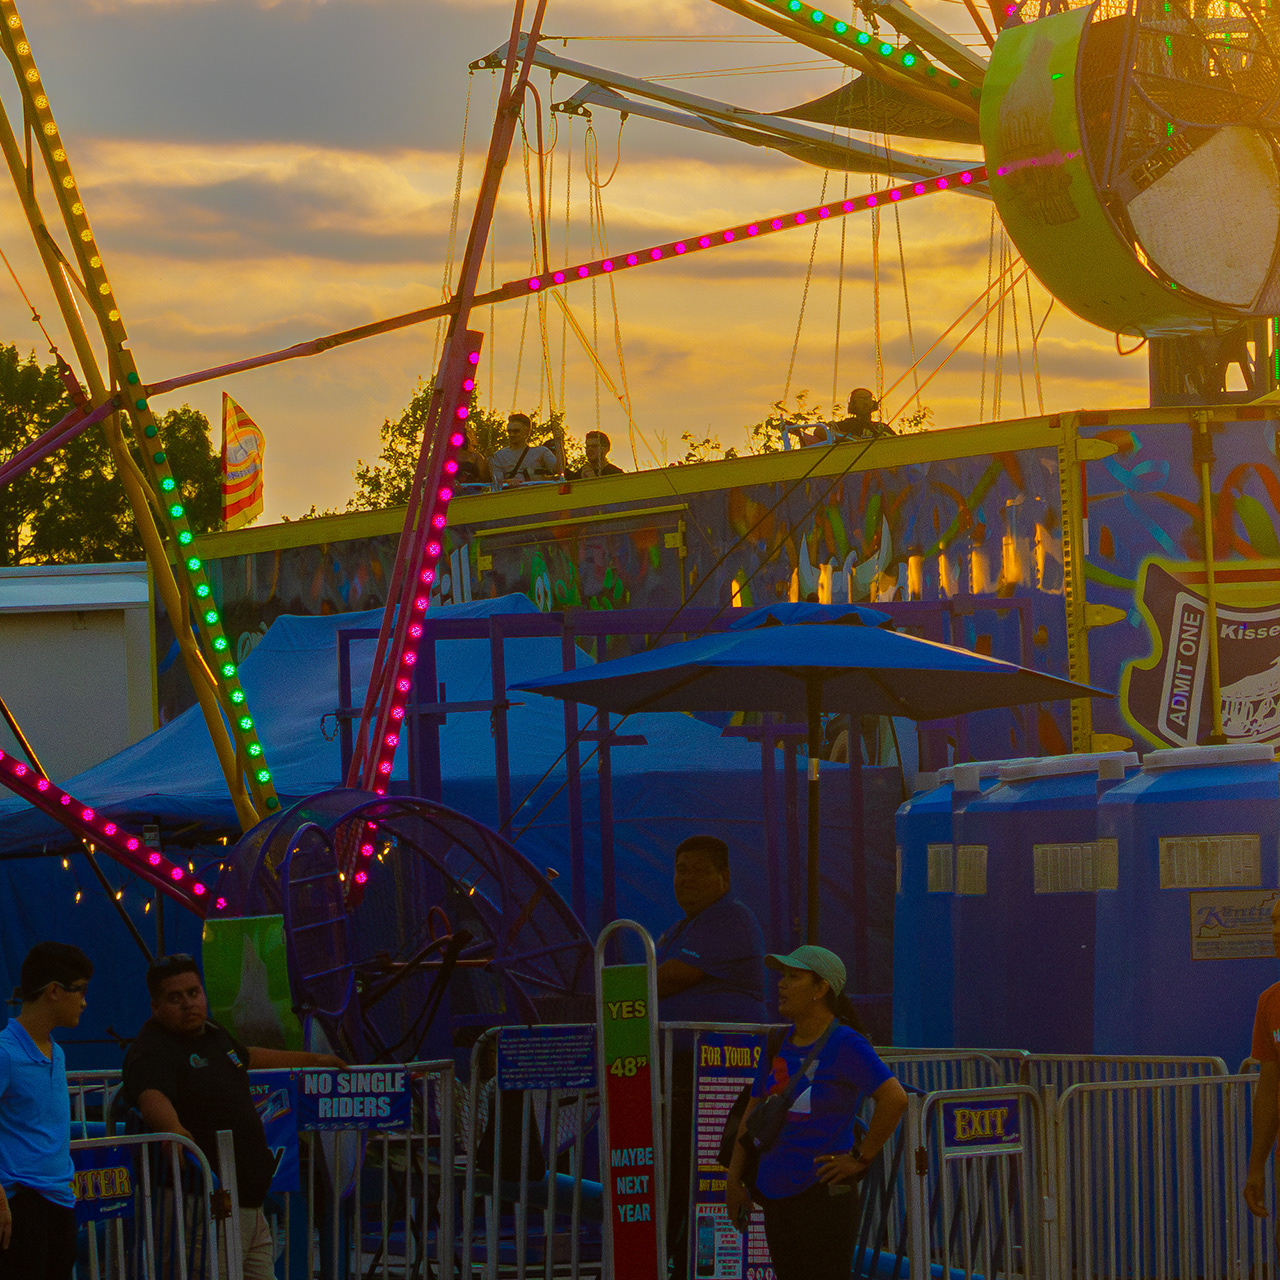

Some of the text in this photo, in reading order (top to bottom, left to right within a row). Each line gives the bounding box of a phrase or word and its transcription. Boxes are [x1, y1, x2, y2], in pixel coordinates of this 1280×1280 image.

[1169, 612, 1201, 727] ADMIT ONE
[607, 1000, 647, 1019] YES
[701, 1045, 721, 1067] FOR
[723, 1045, 751, 1068] YOUR
[304, 1072, 405, 1094] NO SINGLE
[318, 1096, 391, 1118] RIDERS
[953, 1106, 1009, 1141] EXIT
[611, 1147, 653, 1168] MAYBE
[616, 1175, 650, 1195] NEXT
[618, 1203, 651, 1223] YEAR
